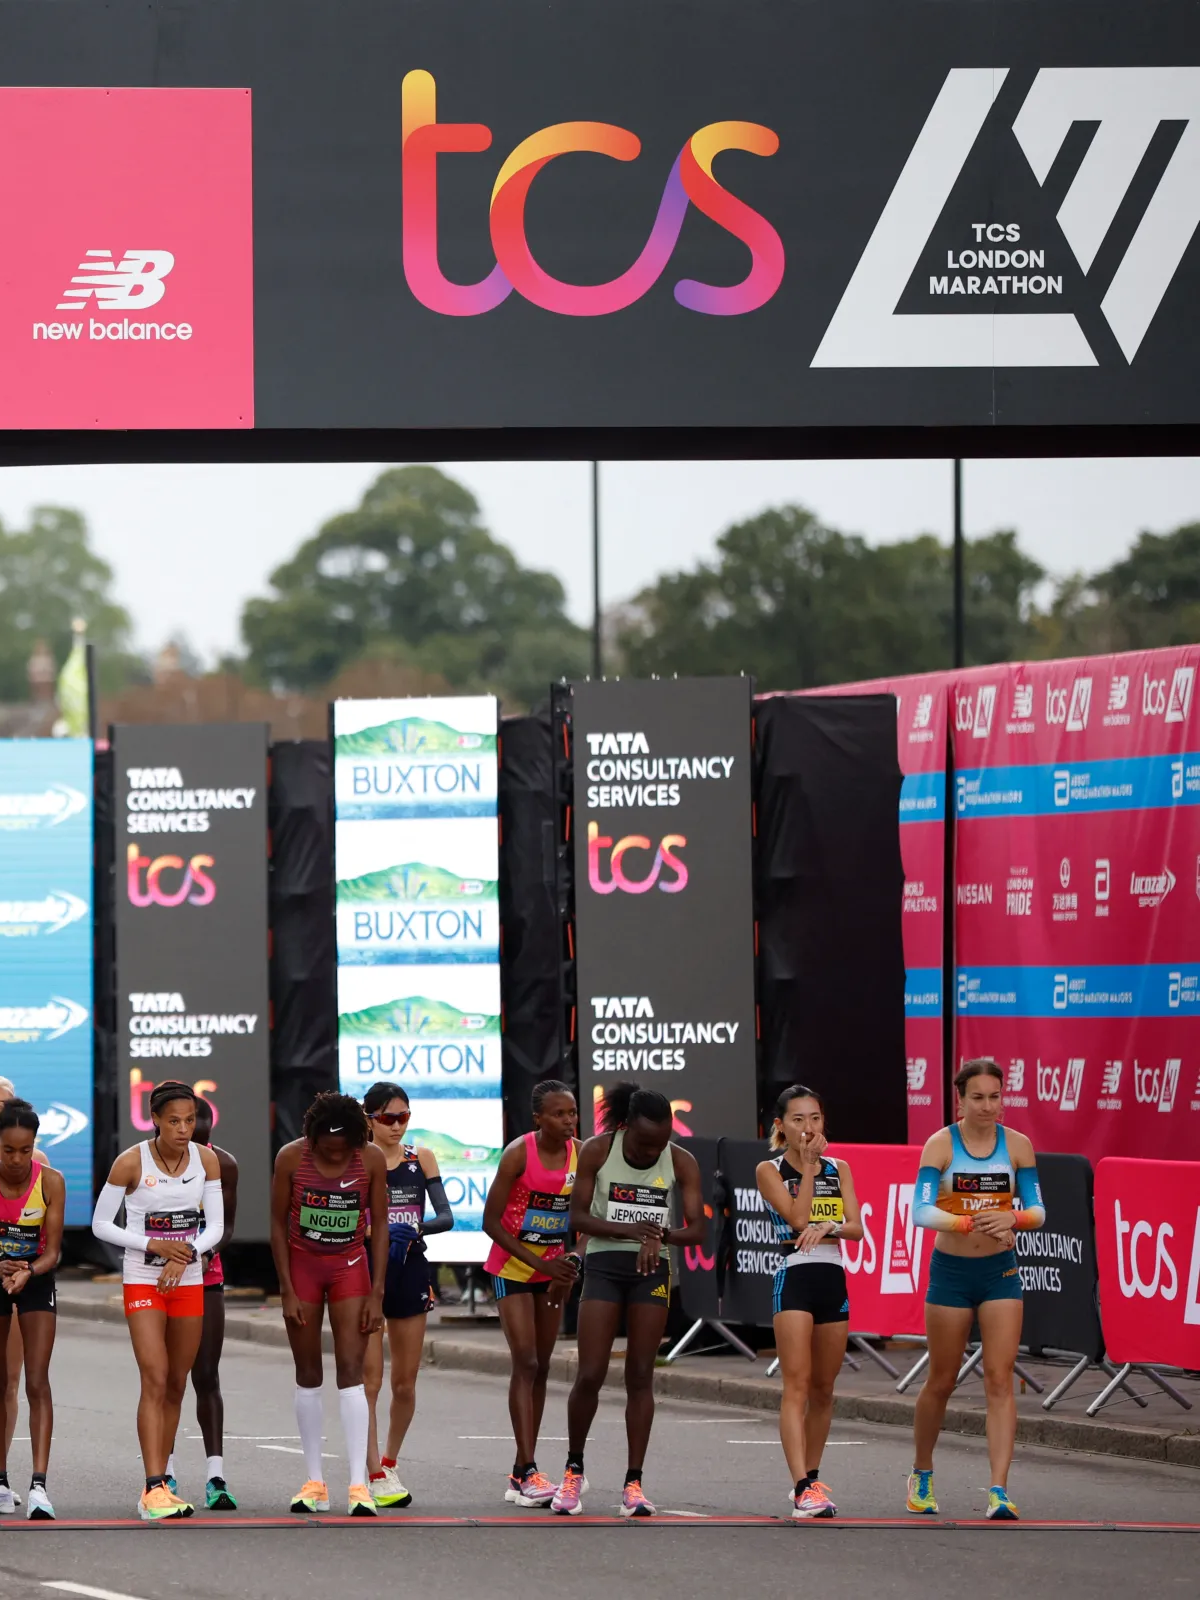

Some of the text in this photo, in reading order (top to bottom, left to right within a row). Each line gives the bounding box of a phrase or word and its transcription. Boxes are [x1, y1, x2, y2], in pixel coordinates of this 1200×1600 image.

[401, 68, 786, 317] tcs
[970, 222, 1021, 244] TCS
[946, 248, 1046, 270] LONDON
[928, 275, 1064, 296] MARATHON
[31, 316, 193, 341] new balance
[1046, 681, 1068, 725] tcs
[1142, 671, 1167, 717] tcs
[586, 732, 650, 756] TATA
[126, 767, 184, 790] TATA
[352, 763, 482, 797] BUXTON
[586, 755, 735, 782] CONSULTANCY
[126, 787, 257, 812] CONSULTANCY
[587, 783, 681, 808] SERVICES
[126, 811, 211, 834] SERVICES
[587, 820, 689, 895] tcs
[126, 842, 217, 908] tcs
[957, 883, 993, 905] NISSAN
[1006, 892, 1032, 916] PRIDE
[354, 908, 483, 942] BUXTON
[128, 993, 185, 1013] TATA
[591, 996, 654, 1019] TATA
[128, 1013, 259, 1037] CONSULTANCY
[591, 1021, 739, 1046] CONSULTANCY
[129, 1036, 213, 1058] SERVICES
[356, 1043, 486, 1076] BUXTON
[591, 1048, 686, 1072] SERVICES
[1036, 1057, 1061, 1104] tcs
[1134, 1058, 1161, 1105] tcs
[614, 1186, 635, 1201] tcs
[957, 1176, 979, 1190] tcs
[307, 1191, 328, 1206] tcs
[961, 1197, 1000, 1210] TWELL
[149, 1215, 171, 1228] tcs
[309, 1213, 350, 1228] NGUGI
[531, 1215, 559, 1230] PACE
[1015, 1231, 1084, 1265] CONSULTANCY
[1114, 1199, 1178, 1301] tcs
[1017, 1265, 1062, 1293] SERVICES
[129, 1299, 152, 1309] INEOS
